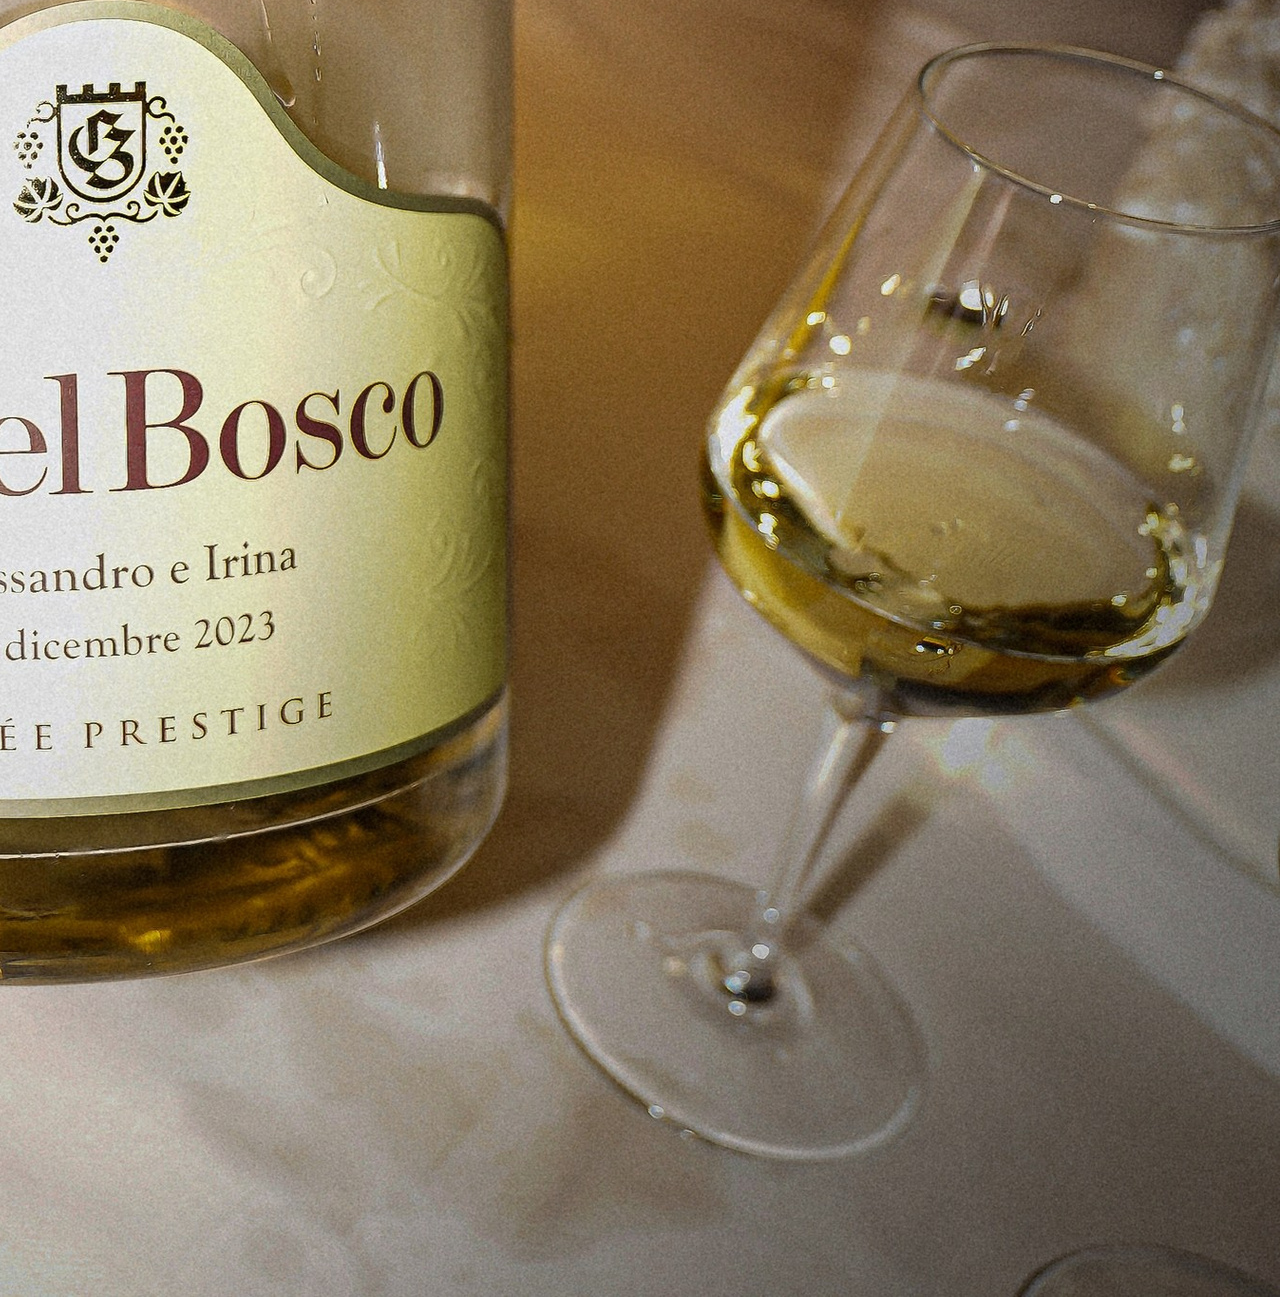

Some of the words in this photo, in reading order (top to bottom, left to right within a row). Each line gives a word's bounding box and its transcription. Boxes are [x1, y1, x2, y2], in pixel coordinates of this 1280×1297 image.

[107, 368, 445, 494] Bosco
[171, 562, 191, 586] e
[205, 542, 298, 582] Irina
[5, 623, 181, 663] dicembre
[195, 610, 277, 651] 2023
[84, 690, 334, 750] PRESTIGE
